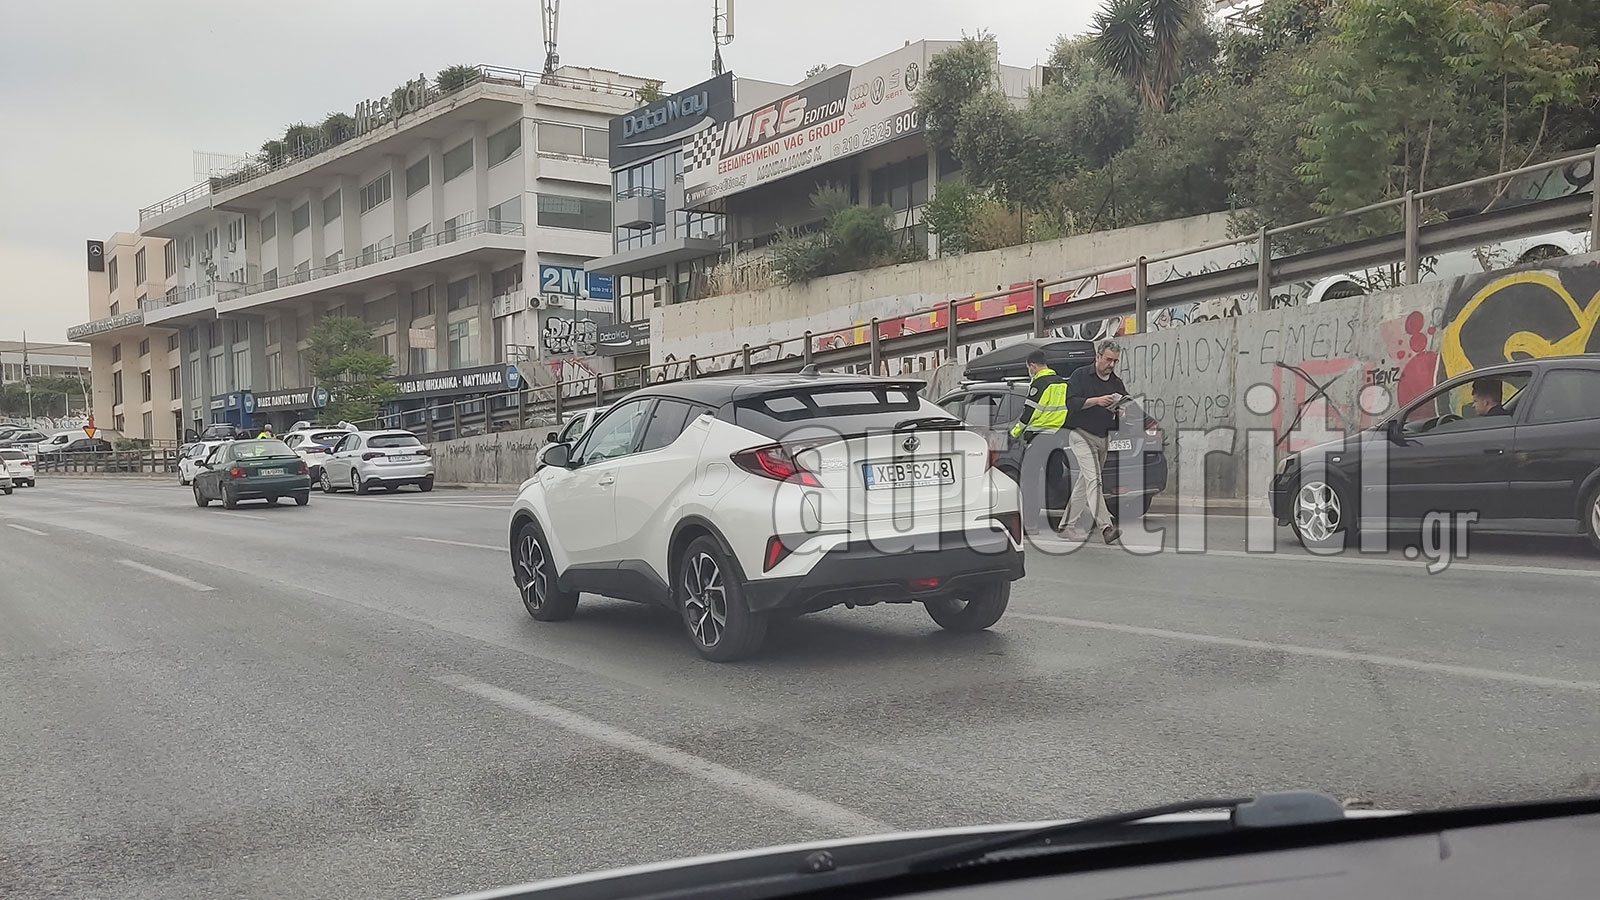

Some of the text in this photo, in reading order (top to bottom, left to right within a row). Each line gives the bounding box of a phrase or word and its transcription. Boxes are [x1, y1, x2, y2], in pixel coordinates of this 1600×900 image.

[853, 101, 867, 112] Audi
[885, 89, 903, 101] SEAT
[623, 91, 708, 138] DataWay
[721, 95, 846, 155] MRS EDITION
[784, 134, 804, 151] VAG
[808, 118, 846, 142] GROUP
[842, 133, 860, 154] 210
[862, 118, 892, 147] 2525
[542, 267, 586, 294] 2M
[600, 330, 630, 342] DataWay
